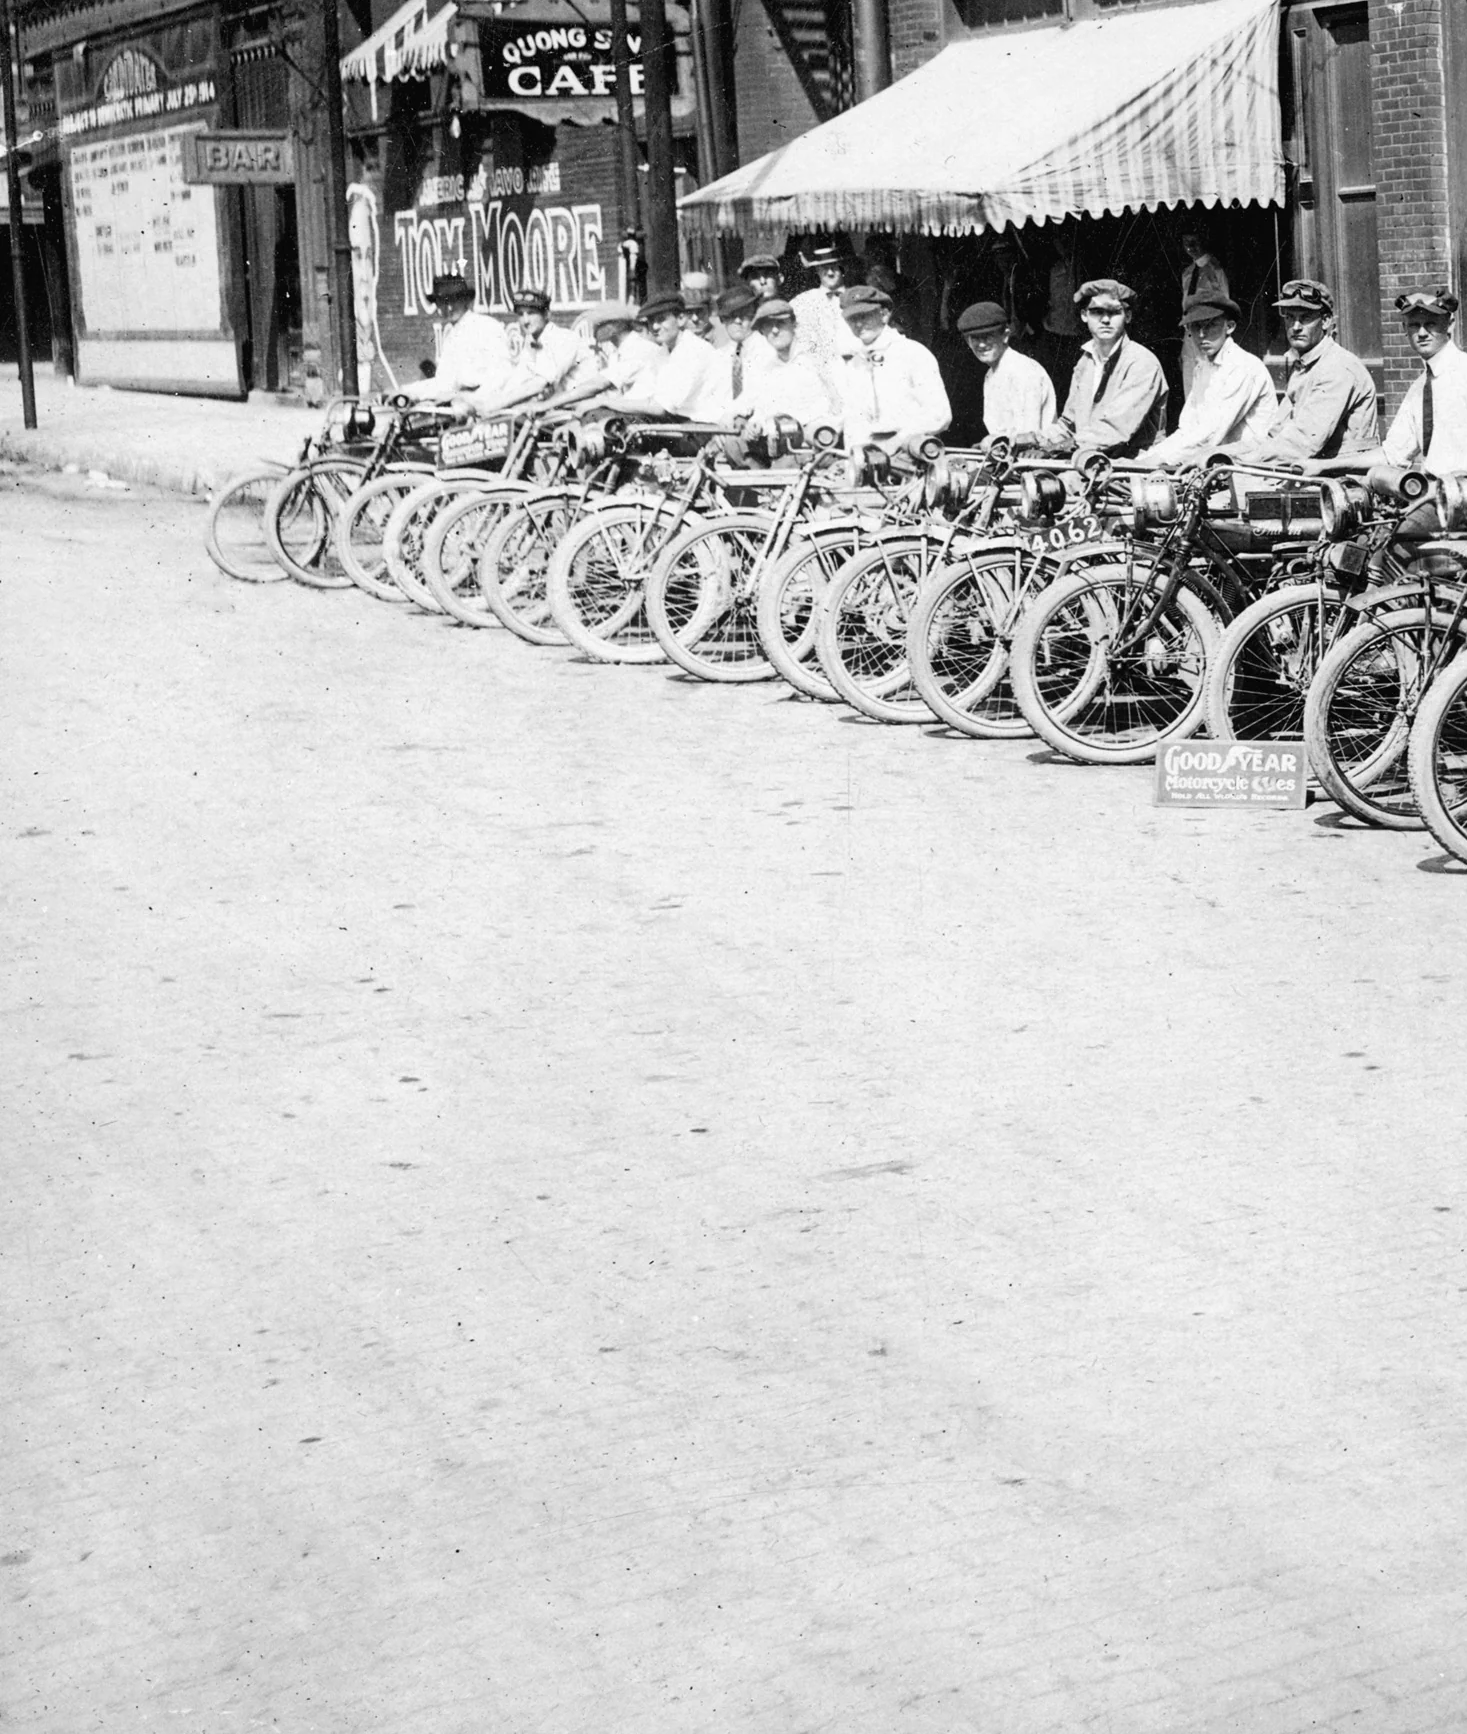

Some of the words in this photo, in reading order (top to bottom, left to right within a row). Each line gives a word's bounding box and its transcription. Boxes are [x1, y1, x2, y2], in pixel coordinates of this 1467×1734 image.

[502, 27, 587, 65] QUONG
[507, 65, 646, 96] CAFE
[207, 144, 281, 172] BAR
[468, 200, 606, 314] MOORE
[1031, 517, 1102, 552] 4062
[1164, 745, 1297, 775] GOODYEAR
[1165, 774, 1249, 793] Motorcycle
